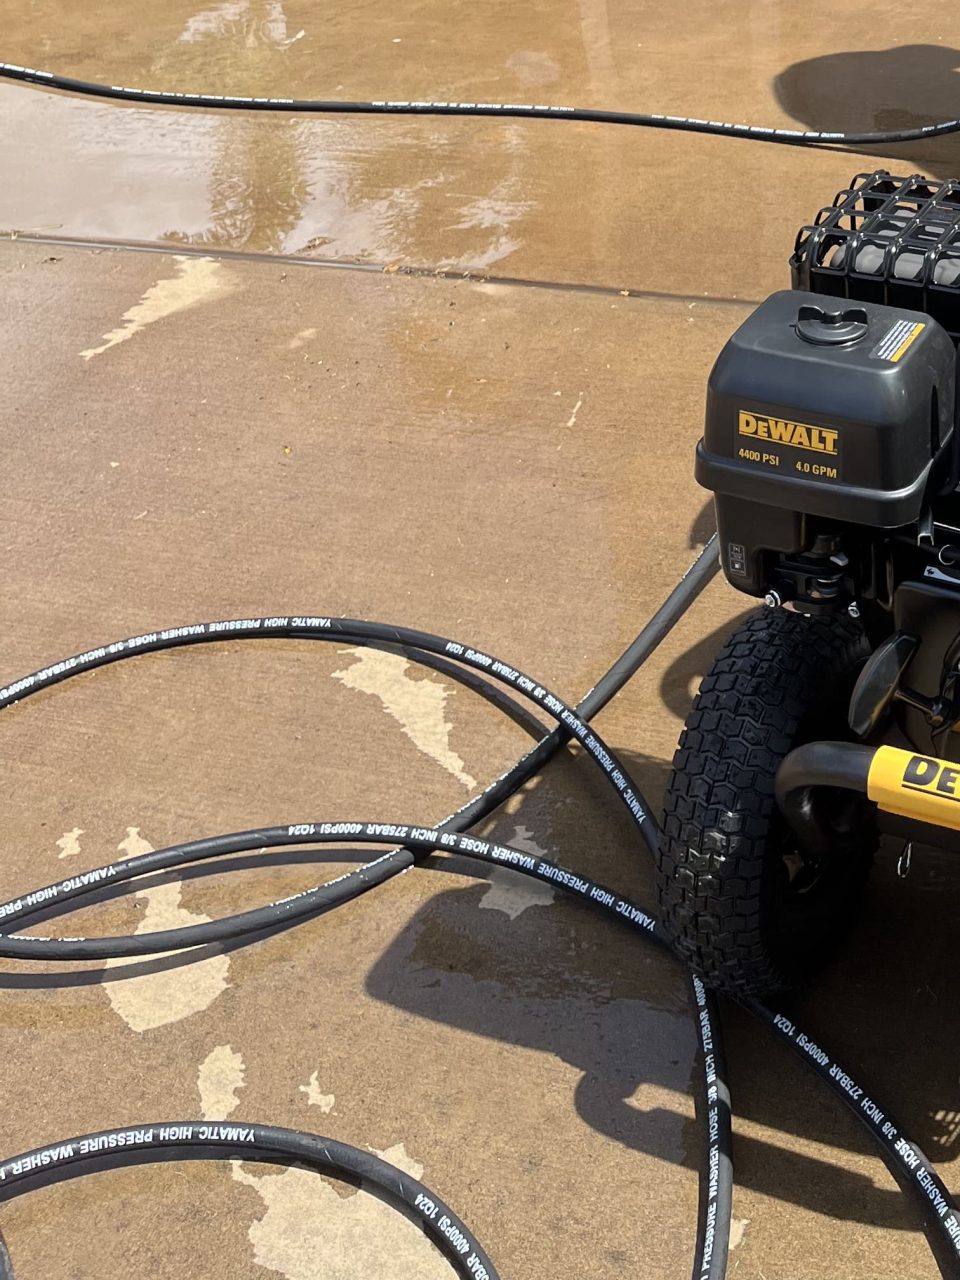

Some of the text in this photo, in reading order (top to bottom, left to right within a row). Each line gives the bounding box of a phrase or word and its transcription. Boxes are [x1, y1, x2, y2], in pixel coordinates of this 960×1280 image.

[739, 412, 838, 453] DEWALT
[738, 448, 838, 478] 4400 PSI 4.0 GPM
[161, 623, 205, 640] WASHER
[208, 618, 260, 632] PRESSURE
[264, 617, 288, 627] HIGH
[292, 616, 332, 627] YAMATIC
[128, 632, 157, 649] HOSE
[38, 657, 77, 680] 275BAR
[80, 646, 106, 665] INCH
[516, 673, 536, 692] INCH
[543, 694, 561, 713] HOSE
[561, 708, 590, 738] WASHER
[585, 735, 613, 773] PRESSURE
[609, 768, 626, 790] HIGH
[623, 784, 647, 825] YAMATIC
[62, 865, 117, 894] YAMATIC
[288, 822, 657, 933] YAMATIC HIGH PRESSURE WASHER HOSE 3/8 INCH 275BAR 4000PSI 1Q24
[27, 885, 57, 906] HIGH
[693, 974, 706, 1006] 4000P
[699, 1009, 715, 1053] 275BAR
[773, 1013, 798, 1037] 1Q24
[796, 1033, 830, 1066] 4000PSI
[704, 1053, 717, 1085] INCH
[829, 1063, 864, 1100] 275BAR
[708, 1086, 718, 1105] 3/8
[709, 1108, 719, 1147] HOSE
[860, 1096, 888, 1132] INCH
[80, 1129, 153, 1154] PRESSURE
[159, 1125, 193, 1141] HIGH
[199, 1125, 256, 1143] YAMATIC
[882, 1121, 898, 1140] 3/8
[12, 1142, 74, 1175] WASHER
[894, 1136, 921, 1169] HOSE
[708, 1144, 720, 1202] WASHER
[414, 1193, 440, 1219] 1Q24
[914, 1166, 950, 1218] WASHER
[438, 1215, 470, 1254] 4000PSI
[702, 1201, 717, 1271] PRESSURE
